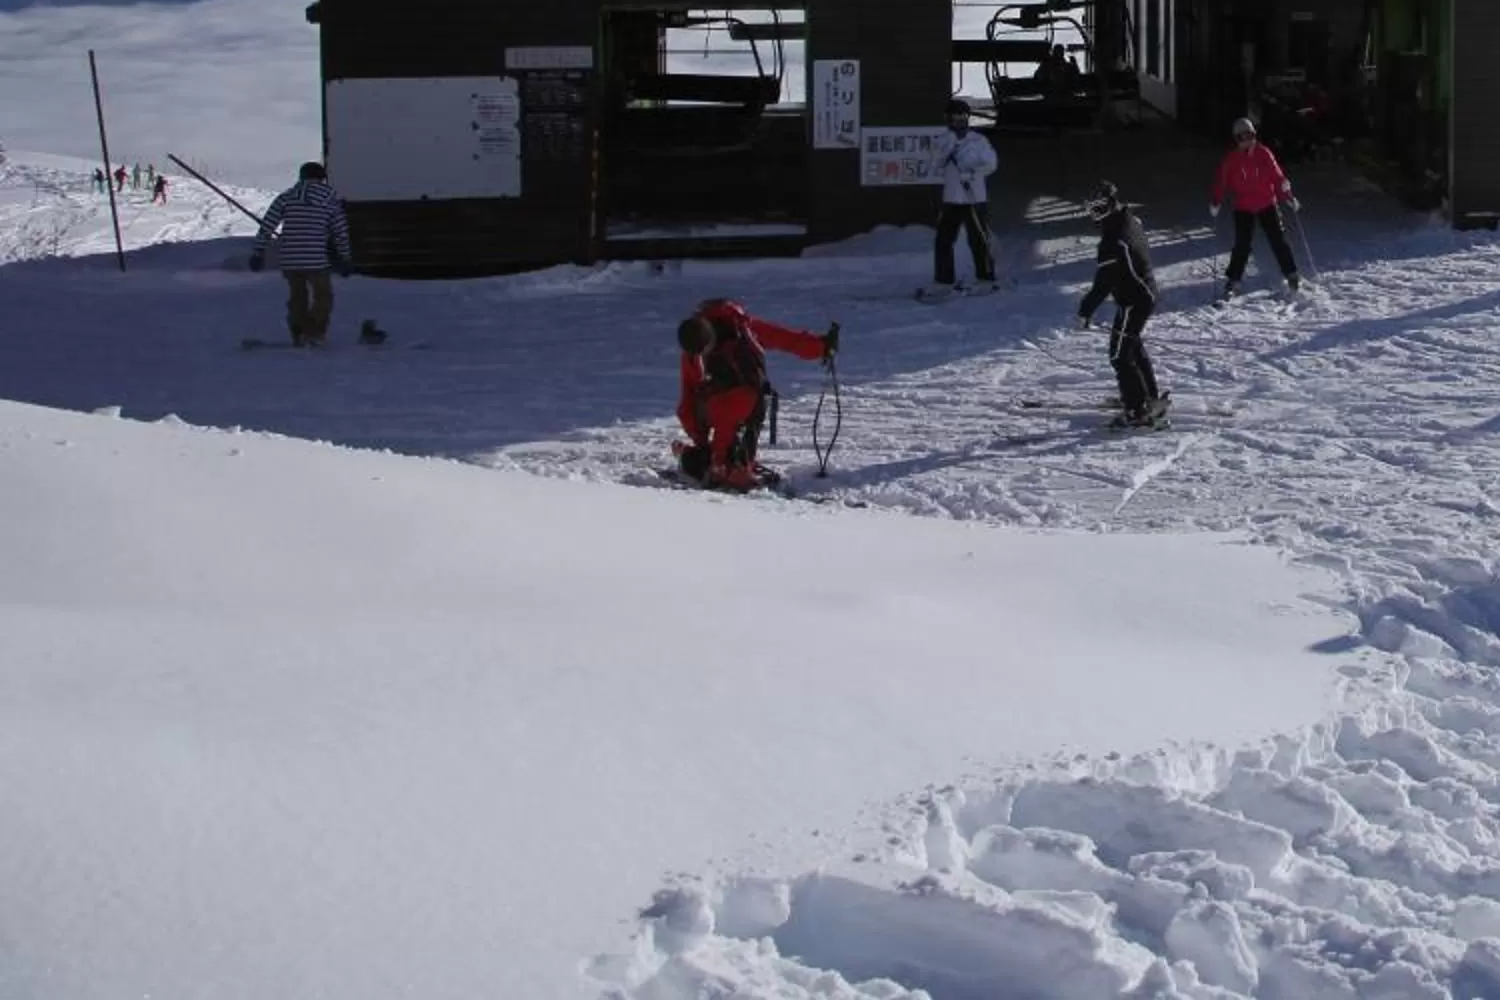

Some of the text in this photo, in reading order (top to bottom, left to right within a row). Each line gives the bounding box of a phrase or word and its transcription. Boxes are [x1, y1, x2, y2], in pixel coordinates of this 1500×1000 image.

[867, 135, 944, 153] 運転終了時
